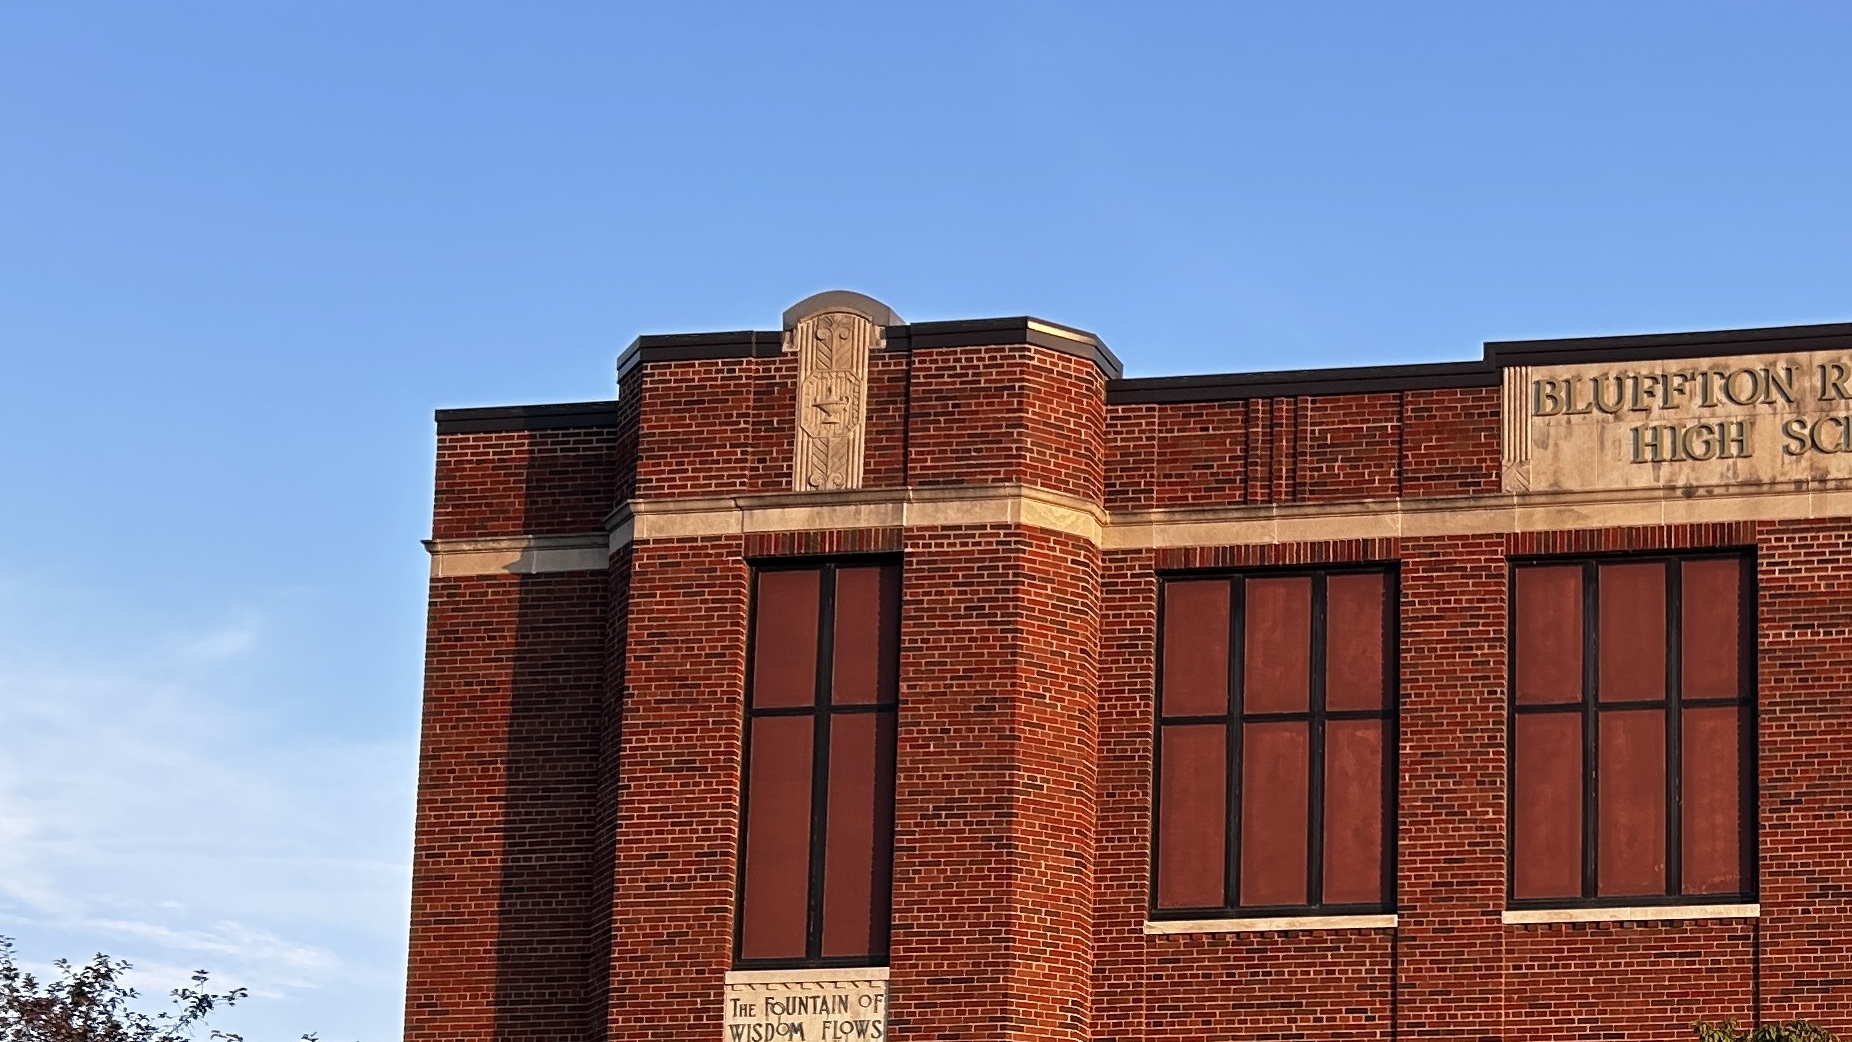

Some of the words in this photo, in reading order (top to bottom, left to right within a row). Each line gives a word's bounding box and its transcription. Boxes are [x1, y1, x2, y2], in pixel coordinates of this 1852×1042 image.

[1533, 368, 1796, 417] BLUFFTON
[1631, 420, 1754, 464] HIGH
[729, 998, 756, 1018] THE
[765, 996, 849, 1016] FOUNTAIN
[858, 993, 884, 1014] OF
[728, 1021, 806, 1042] WISDOM
[821, 1019, 882, 1041] FLOWS
